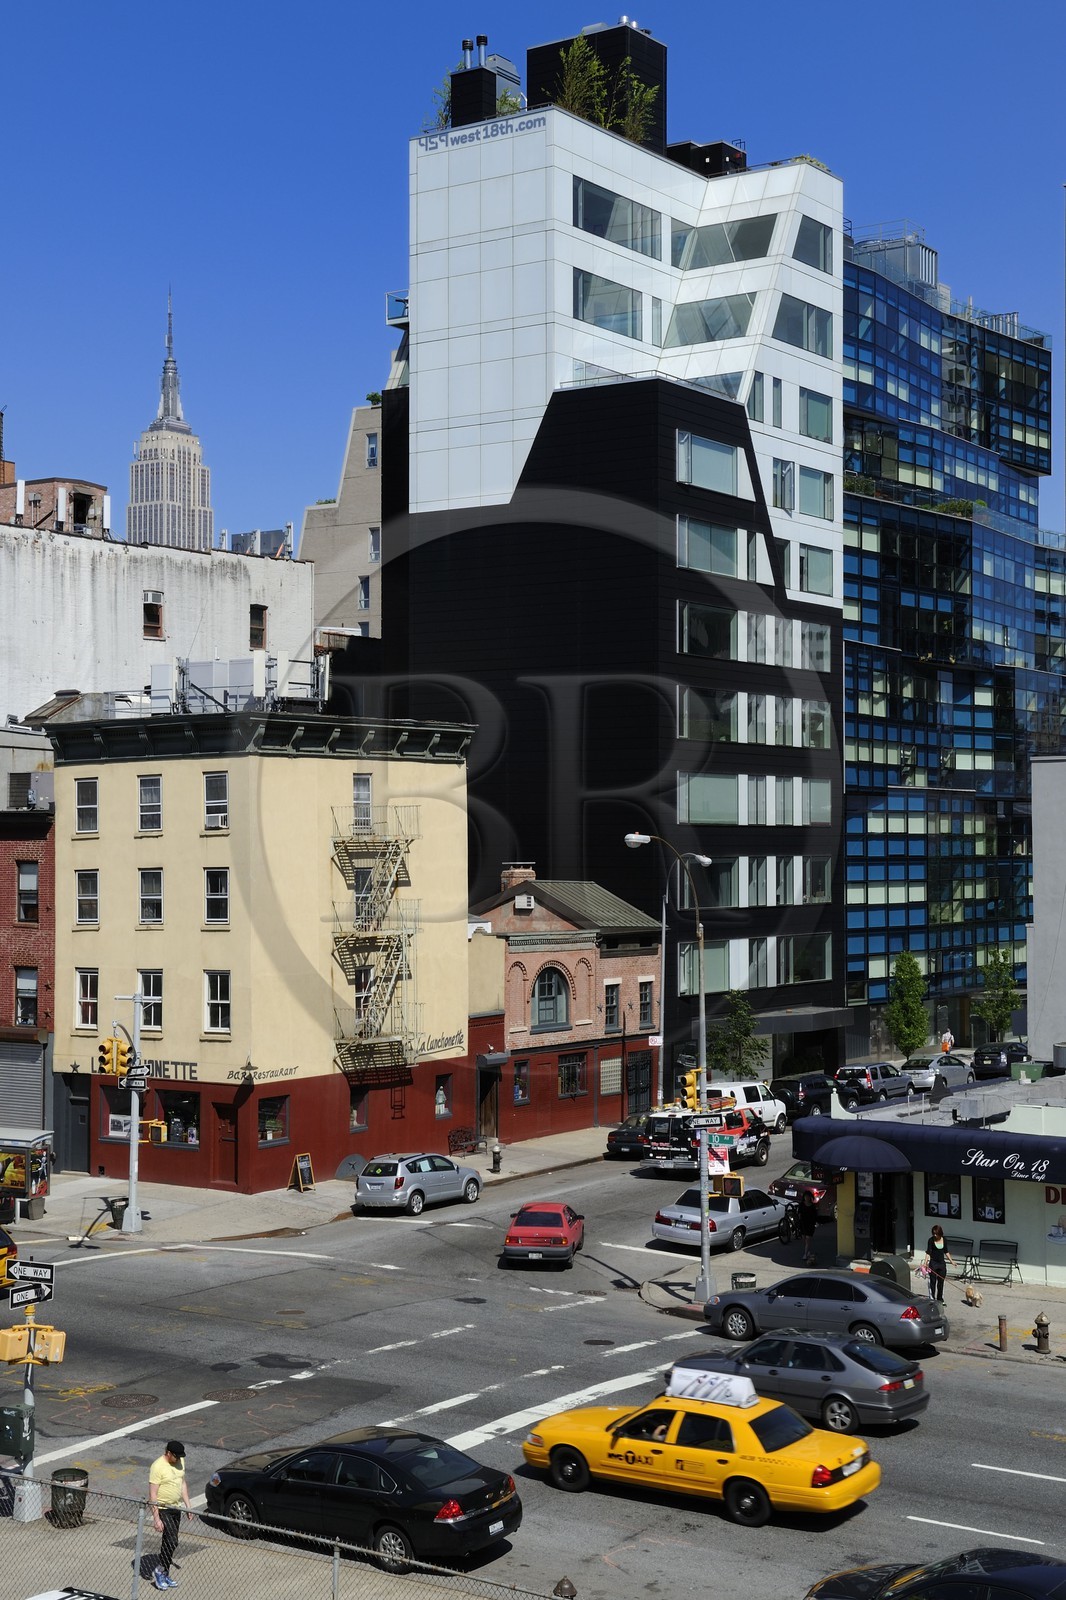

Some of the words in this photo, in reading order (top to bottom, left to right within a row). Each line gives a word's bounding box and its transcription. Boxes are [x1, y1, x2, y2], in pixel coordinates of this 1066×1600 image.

[712, 1133, 720, 1143] 10
[961, 1148, 999, 1168] Star
[1002, 1153, 1025, 1170] On
[1030, 1160, 1050, 1172] 18
[1010, 1170, 1029, 1179] Diner
[13, 1266, 27, 1276] ONE
[33, 1268, 48, 1278] WAY
[16, 1291, 29, 1302] ONE
